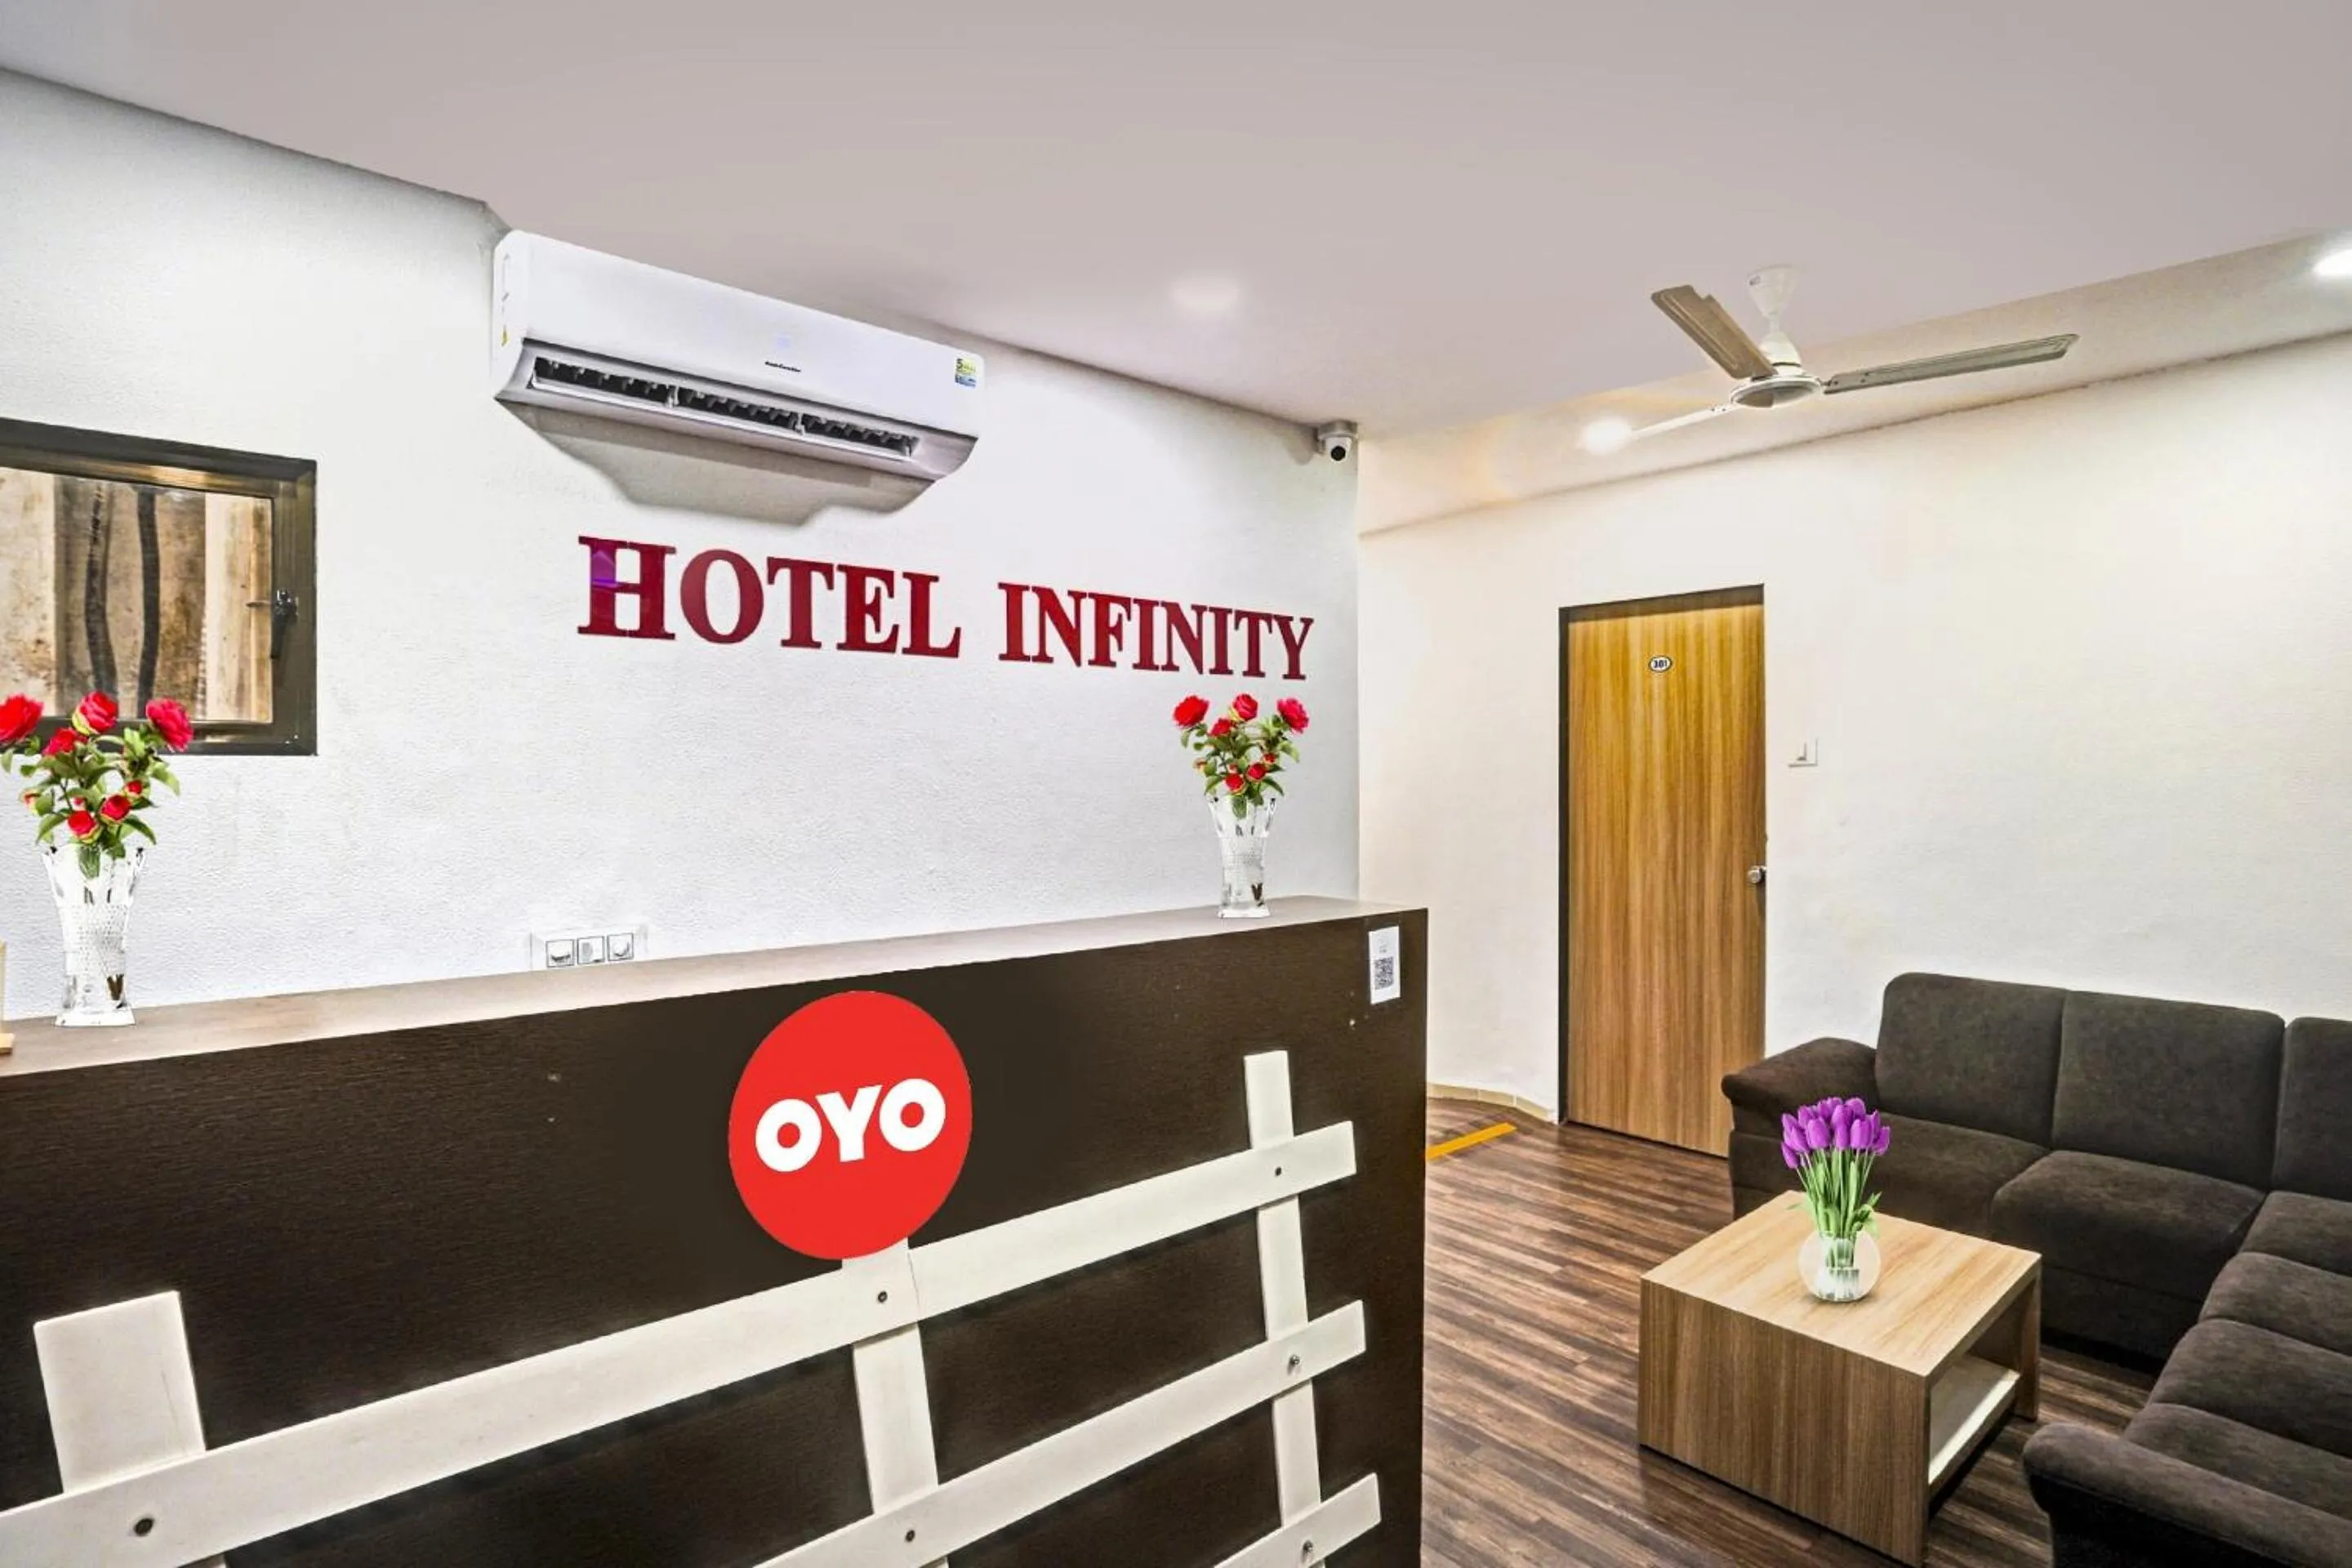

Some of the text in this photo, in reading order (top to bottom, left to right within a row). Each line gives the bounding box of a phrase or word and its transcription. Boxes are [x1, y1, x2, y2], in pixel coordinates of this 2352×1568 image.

[577, 536, 1315, 680] HOTEL INFINITY
[755, 1078, 947, 1172] OYO
